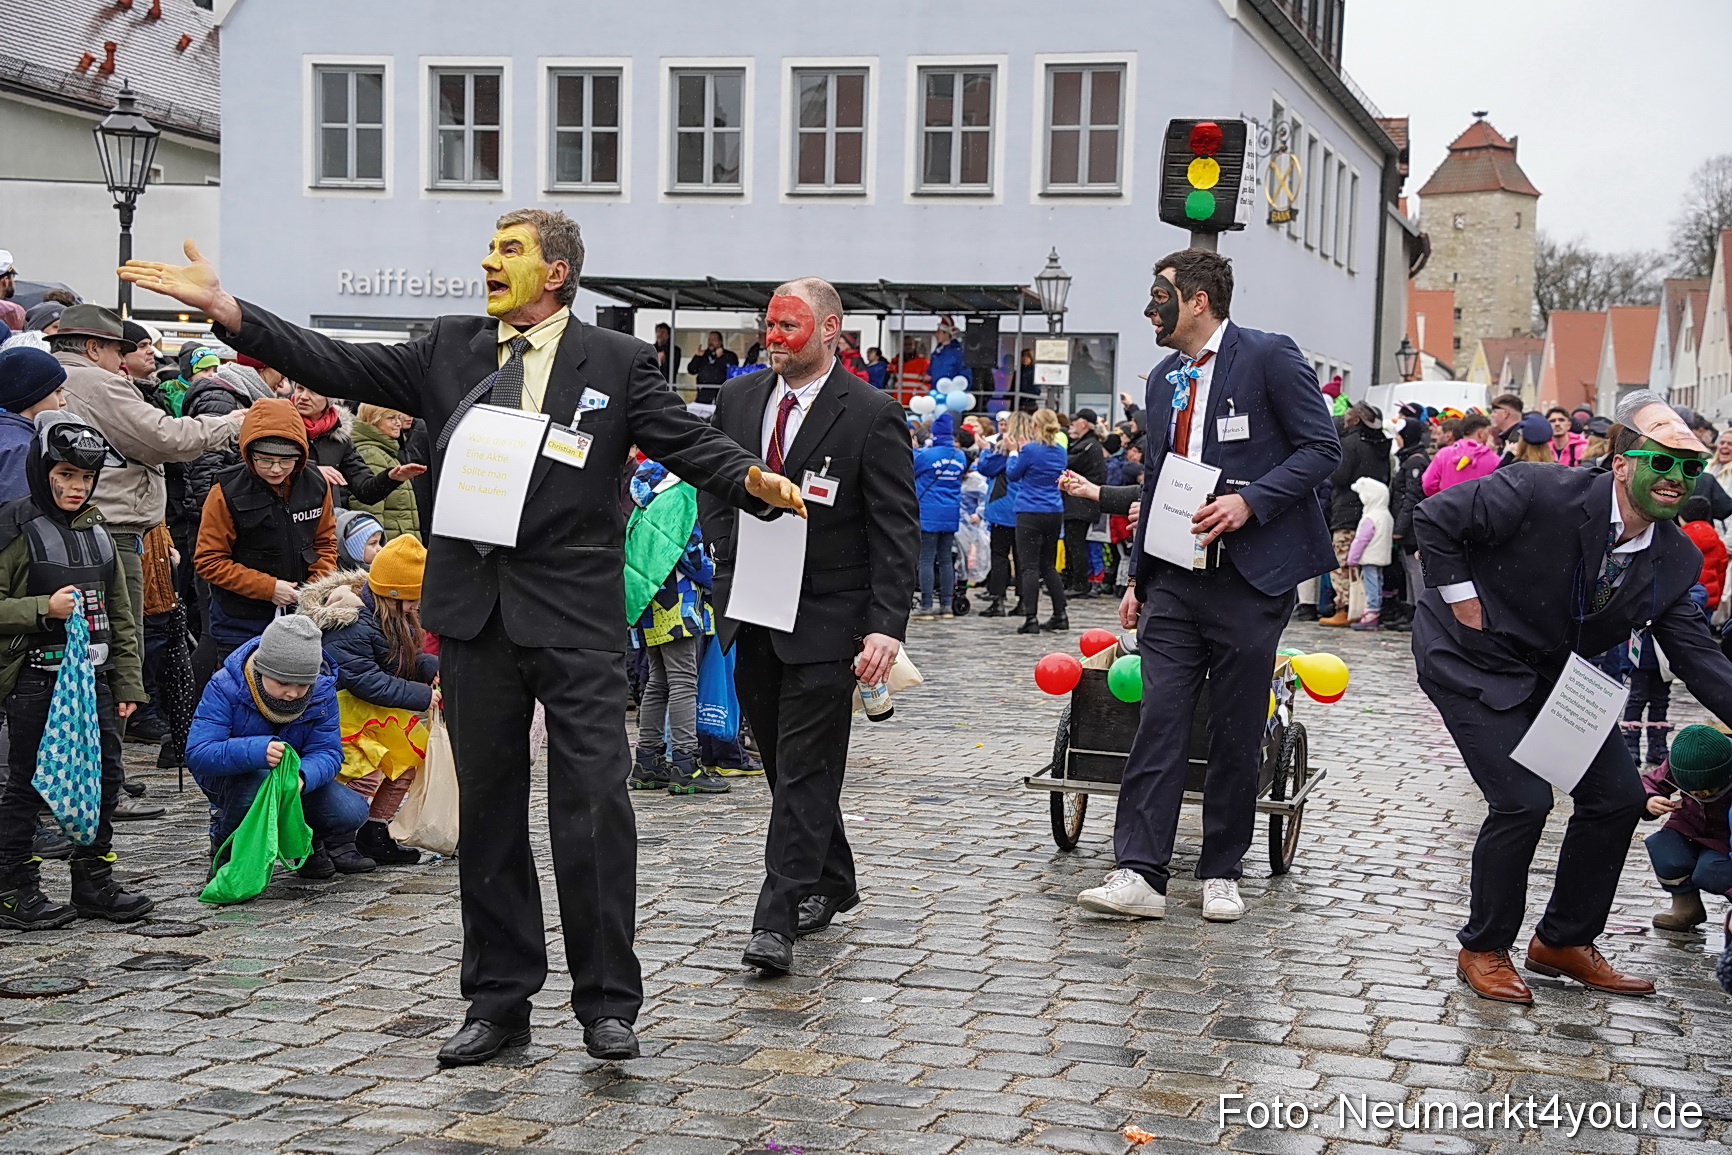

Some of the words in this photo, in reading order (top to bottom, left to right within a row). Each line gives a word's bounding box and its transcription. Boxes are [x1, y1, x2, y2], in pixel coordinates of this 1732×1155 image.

[336, 268, 484, 298] Raiffeisen
[492, 437, 507, 446] die
[509, 439, 528, 450] FDP
[548, 440, 576, 456] Christian
[466, 448, 485, 460] Eine
[486, 452, 509, 464] Aktie
[462, 465, 486, 477] Sollte
[487, 471, 508, 480] man
[458, 481, 476, 492] Nun
[478, 484, 508, 498] kaufen
[1174, 480, 1184, 489] bin
[1184, 483, 1193, 492] für
[1572, 666, 1604, 691] Vaterlandsliebe
[1603, 687, 1614, 698] fand
[1576, 680, 1586, 690] stets
[1585, 688, 1594, 696] zum
[1560, 691, 1586, 712] Deutschland
[1584, 707, 1598, 720] nichts
[1586, 698, 1599, 710] wußte
[1599, 706, 1607, 715] mit
[1562, 714, 1575, 726] heute
[1574, 724, 1586, 734] nicht
[1587, 721, 1598, 731] weiß
